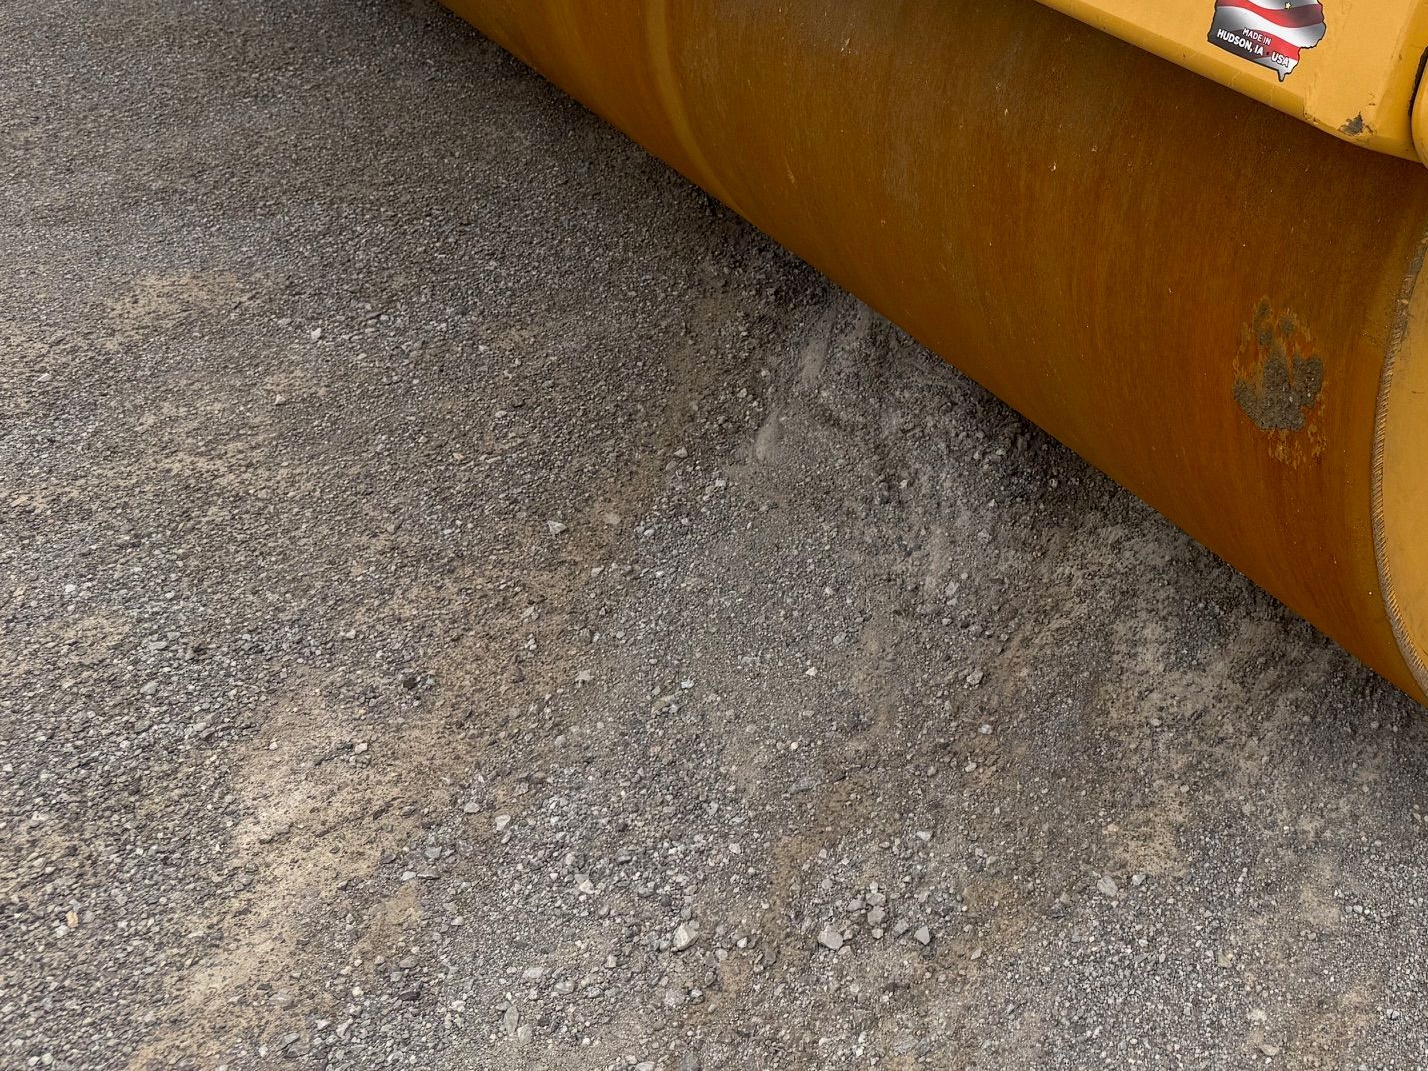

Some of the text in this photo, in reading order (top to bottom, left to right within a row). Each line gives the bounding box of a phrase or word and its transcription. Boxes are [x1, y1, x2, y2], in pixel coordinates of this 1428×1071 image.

[1216, 28, 1291, 68] HUDSON, IA USA
[1242, 28, 1272, 46] MADE IN
